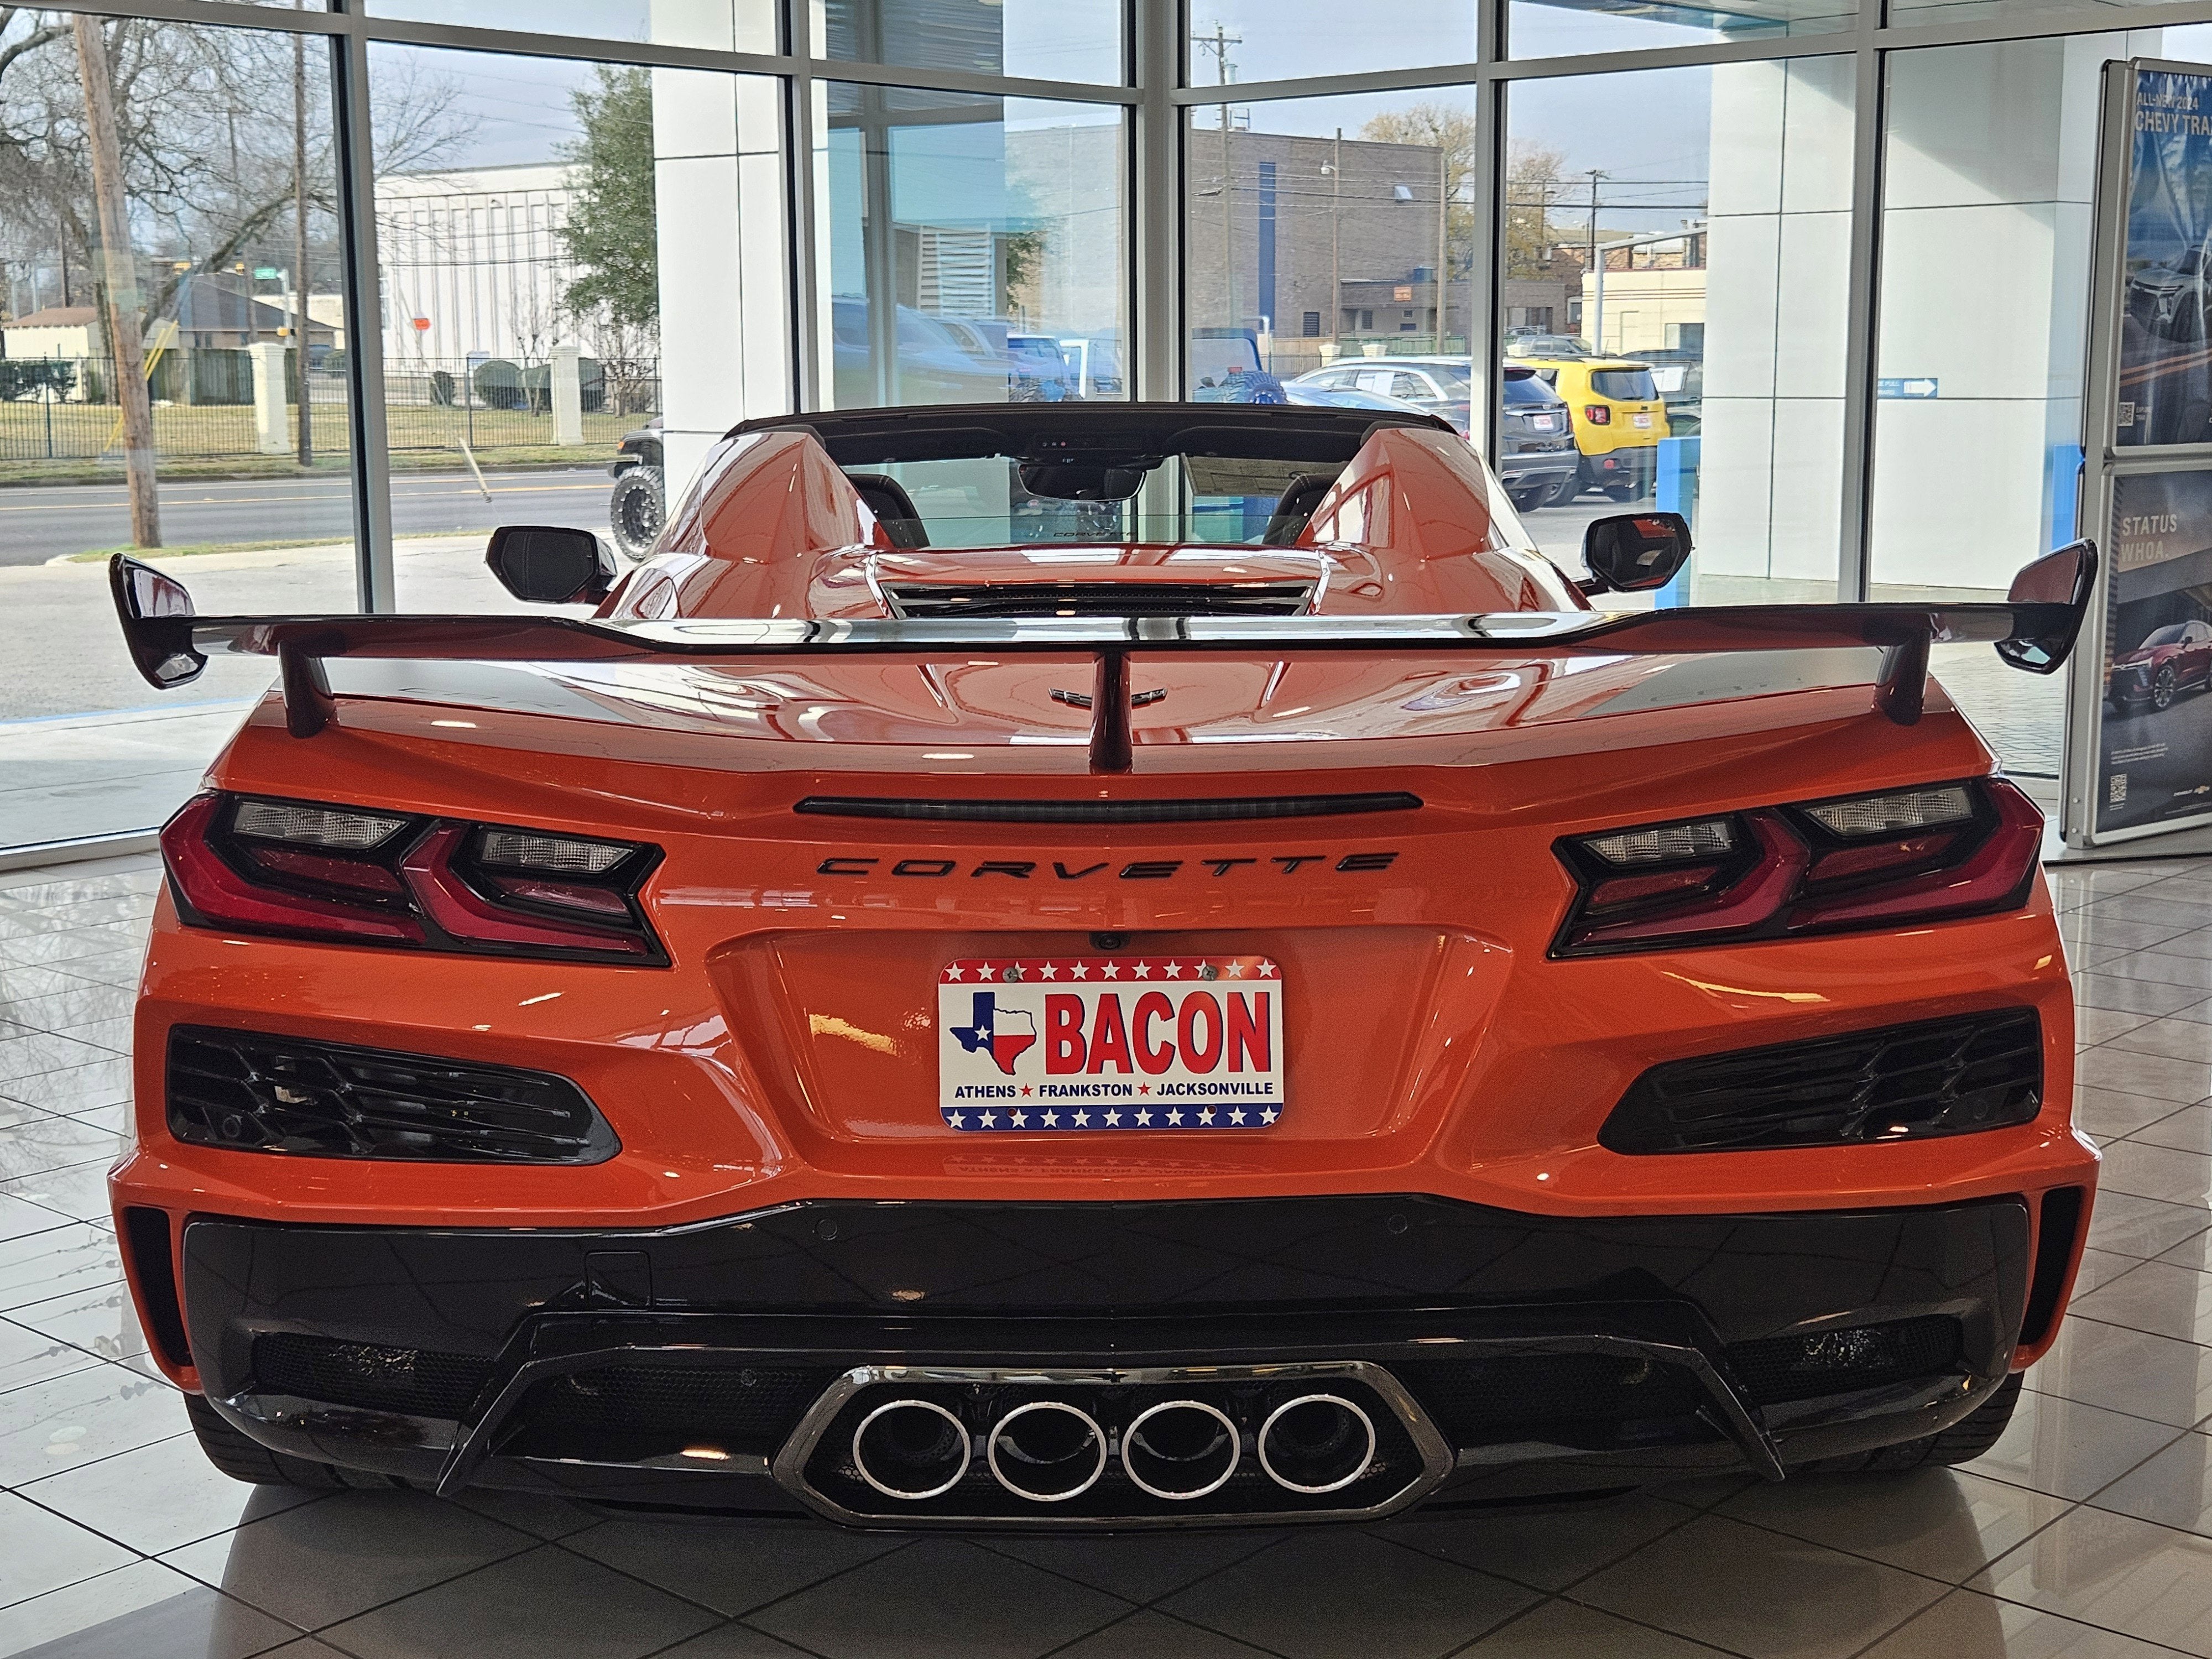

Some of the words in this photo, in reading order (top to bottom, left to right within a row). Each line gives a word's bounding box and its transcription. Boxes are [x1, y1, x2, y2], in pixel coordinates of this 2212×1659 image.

[2137, 92, 2174, 108] ALL-NEW
[2177, 97, 2199, 110] 2024
[2136, 111, 2179, 133] CHEVY
[2183, 115, 2212, 135] TRA
[2122, 514, 2177, 536] STATUS
[2121, 541, 2168, 562] WHOA.
[816, 852, 1399, 880] CORVETTE
[1045, 990, 1272, 1076] BACON
[954, 1084, 1016, 1099] ATHENS
[1039, 1083, 1133, 1098] FRANKSTON
[1156, 1082, 1274, 1097] JACKSONVILLE
